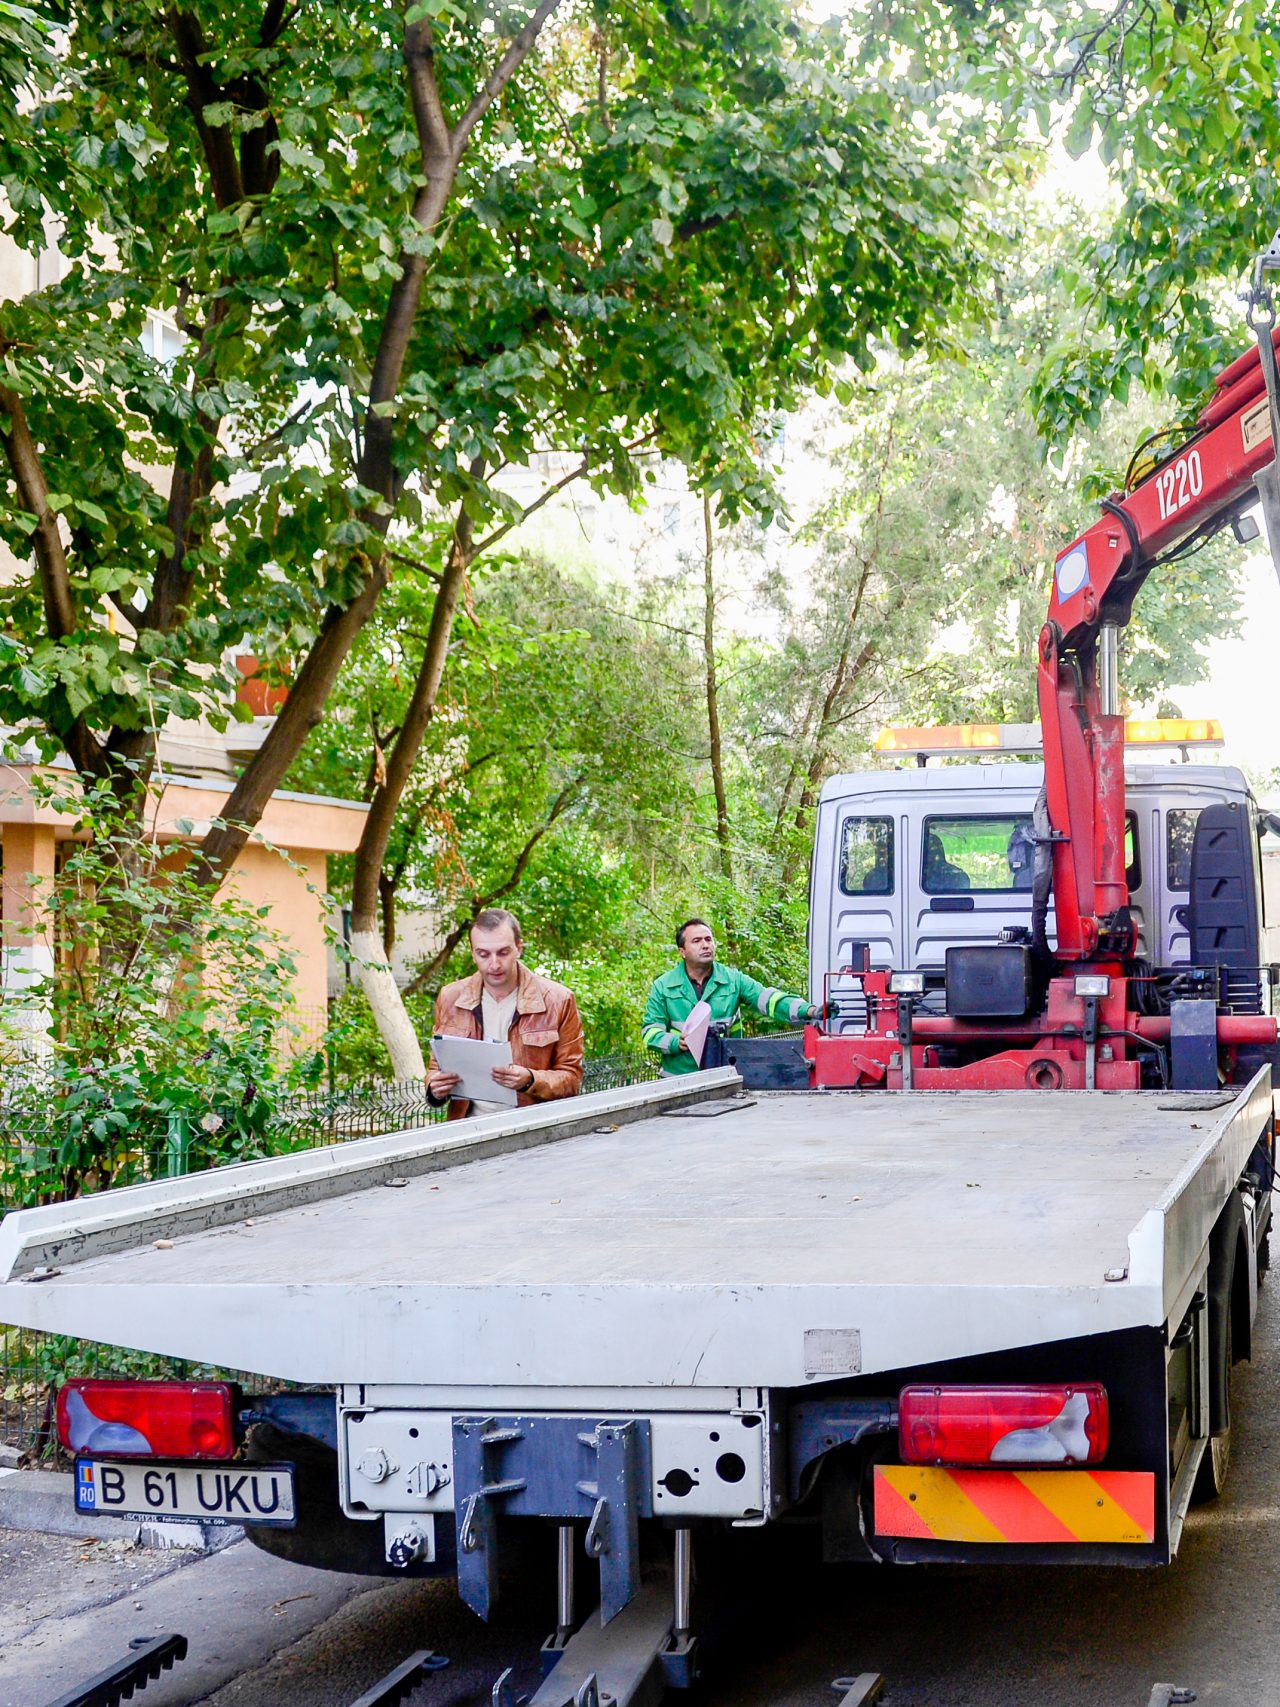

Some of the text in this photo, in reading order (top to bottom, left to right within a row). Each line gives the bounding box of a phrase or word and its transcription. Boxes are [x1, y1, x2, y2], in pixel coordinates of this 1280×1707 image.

[1155, 450, 1203, 520] 1220
[80, 1467, 280, 1514] RO B 61 UKU
